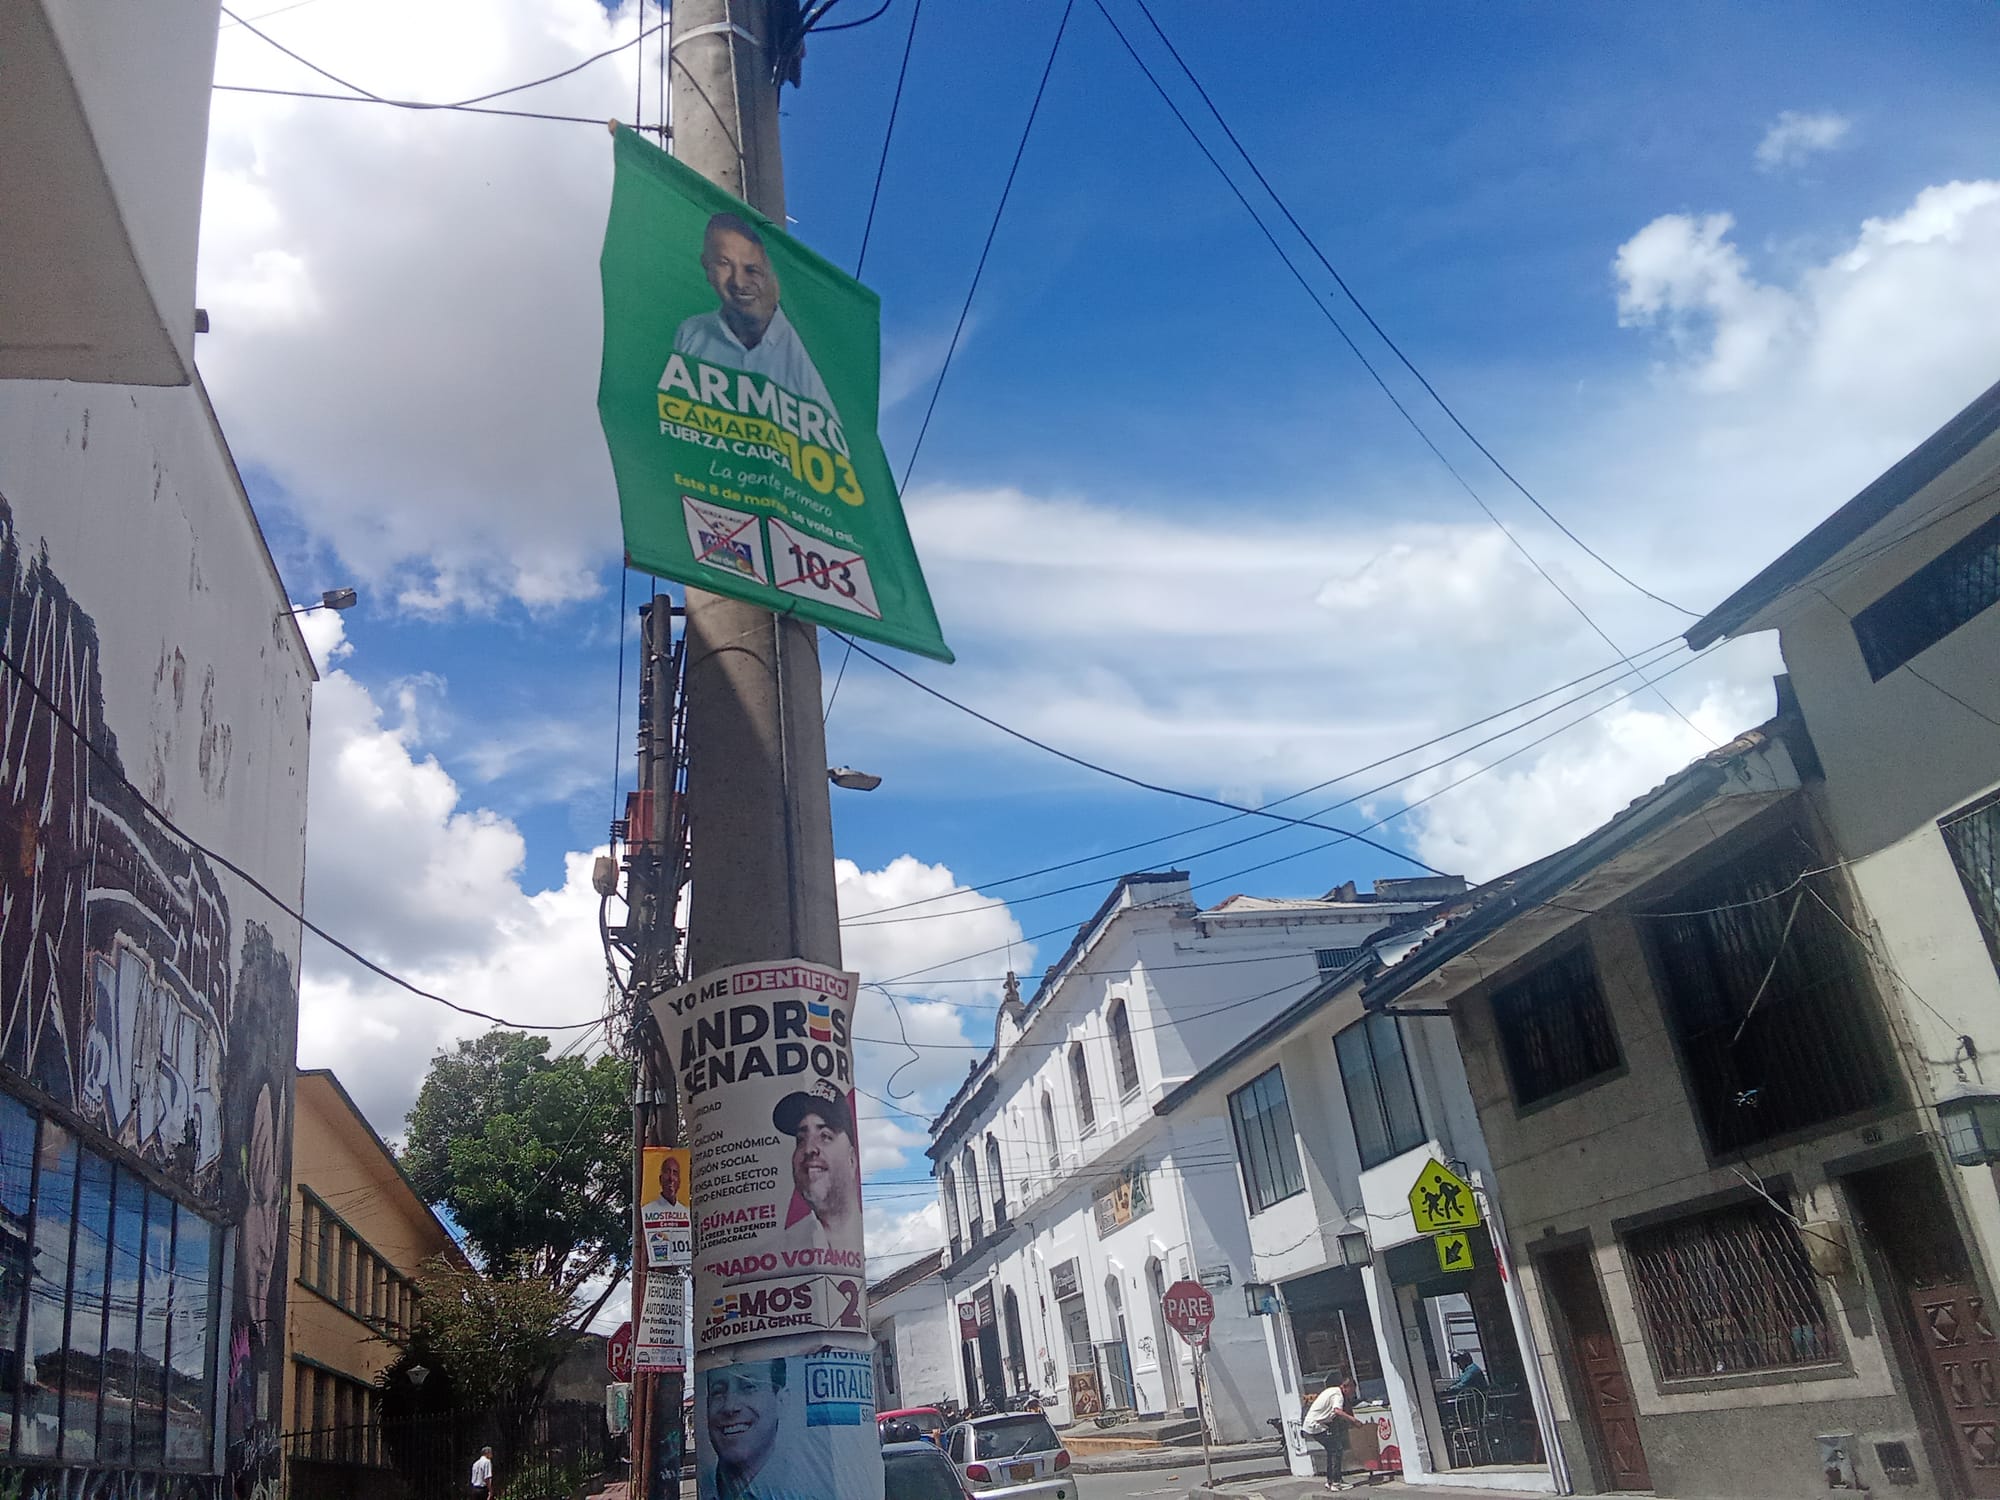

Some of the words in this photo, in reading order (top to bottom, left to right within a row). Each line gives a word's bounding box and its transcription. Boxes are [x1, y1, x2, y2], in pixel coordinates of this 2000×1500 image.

[658, 353, 850, 459] ARMERO
[663, 402, 789, 449] CAMARA
[660, 420, 728, 452] FUERZA
[733, 441, 791, 472] CAUCA
[781, 431, 865, 506] 103
[709, 460, 732, 479] La
[737, 471, 781, 490] gente
[783, 484, 832, 517] primero
[722, 487, 741, 501] de
[788, 542, 857, 599] 103
[667, 993, 697, 1016] YO
[701, 979, 729, 1003] ME
[734, 968, 847, 997] IDENTIFICO
[715, 1136, 781, 1156] ECONÓMICA
[720, 1154, 759, 1169] SOCIAL
[714, 1175, 734, 1187] DEL
[735, 1167, 779, 1182] SECTOR
[733, 1221, 777, 1234] DEFENDER
[672, 1240, 692, 1253] 101
[708, 1232, 758, 1248] DEMOCRACIA
[781, 1247, 862, 1269] VOTAMOS
[836, 1279, 862, 1328] 2
[1167, 1296, 1209, 1318] PARE
[732, 1323, 749, 1335] DE
[749, 1318, 767, 1331] LA
[768, 1312, 813, 1329] GENTE
[612, 1342, 632, 1365] PA
